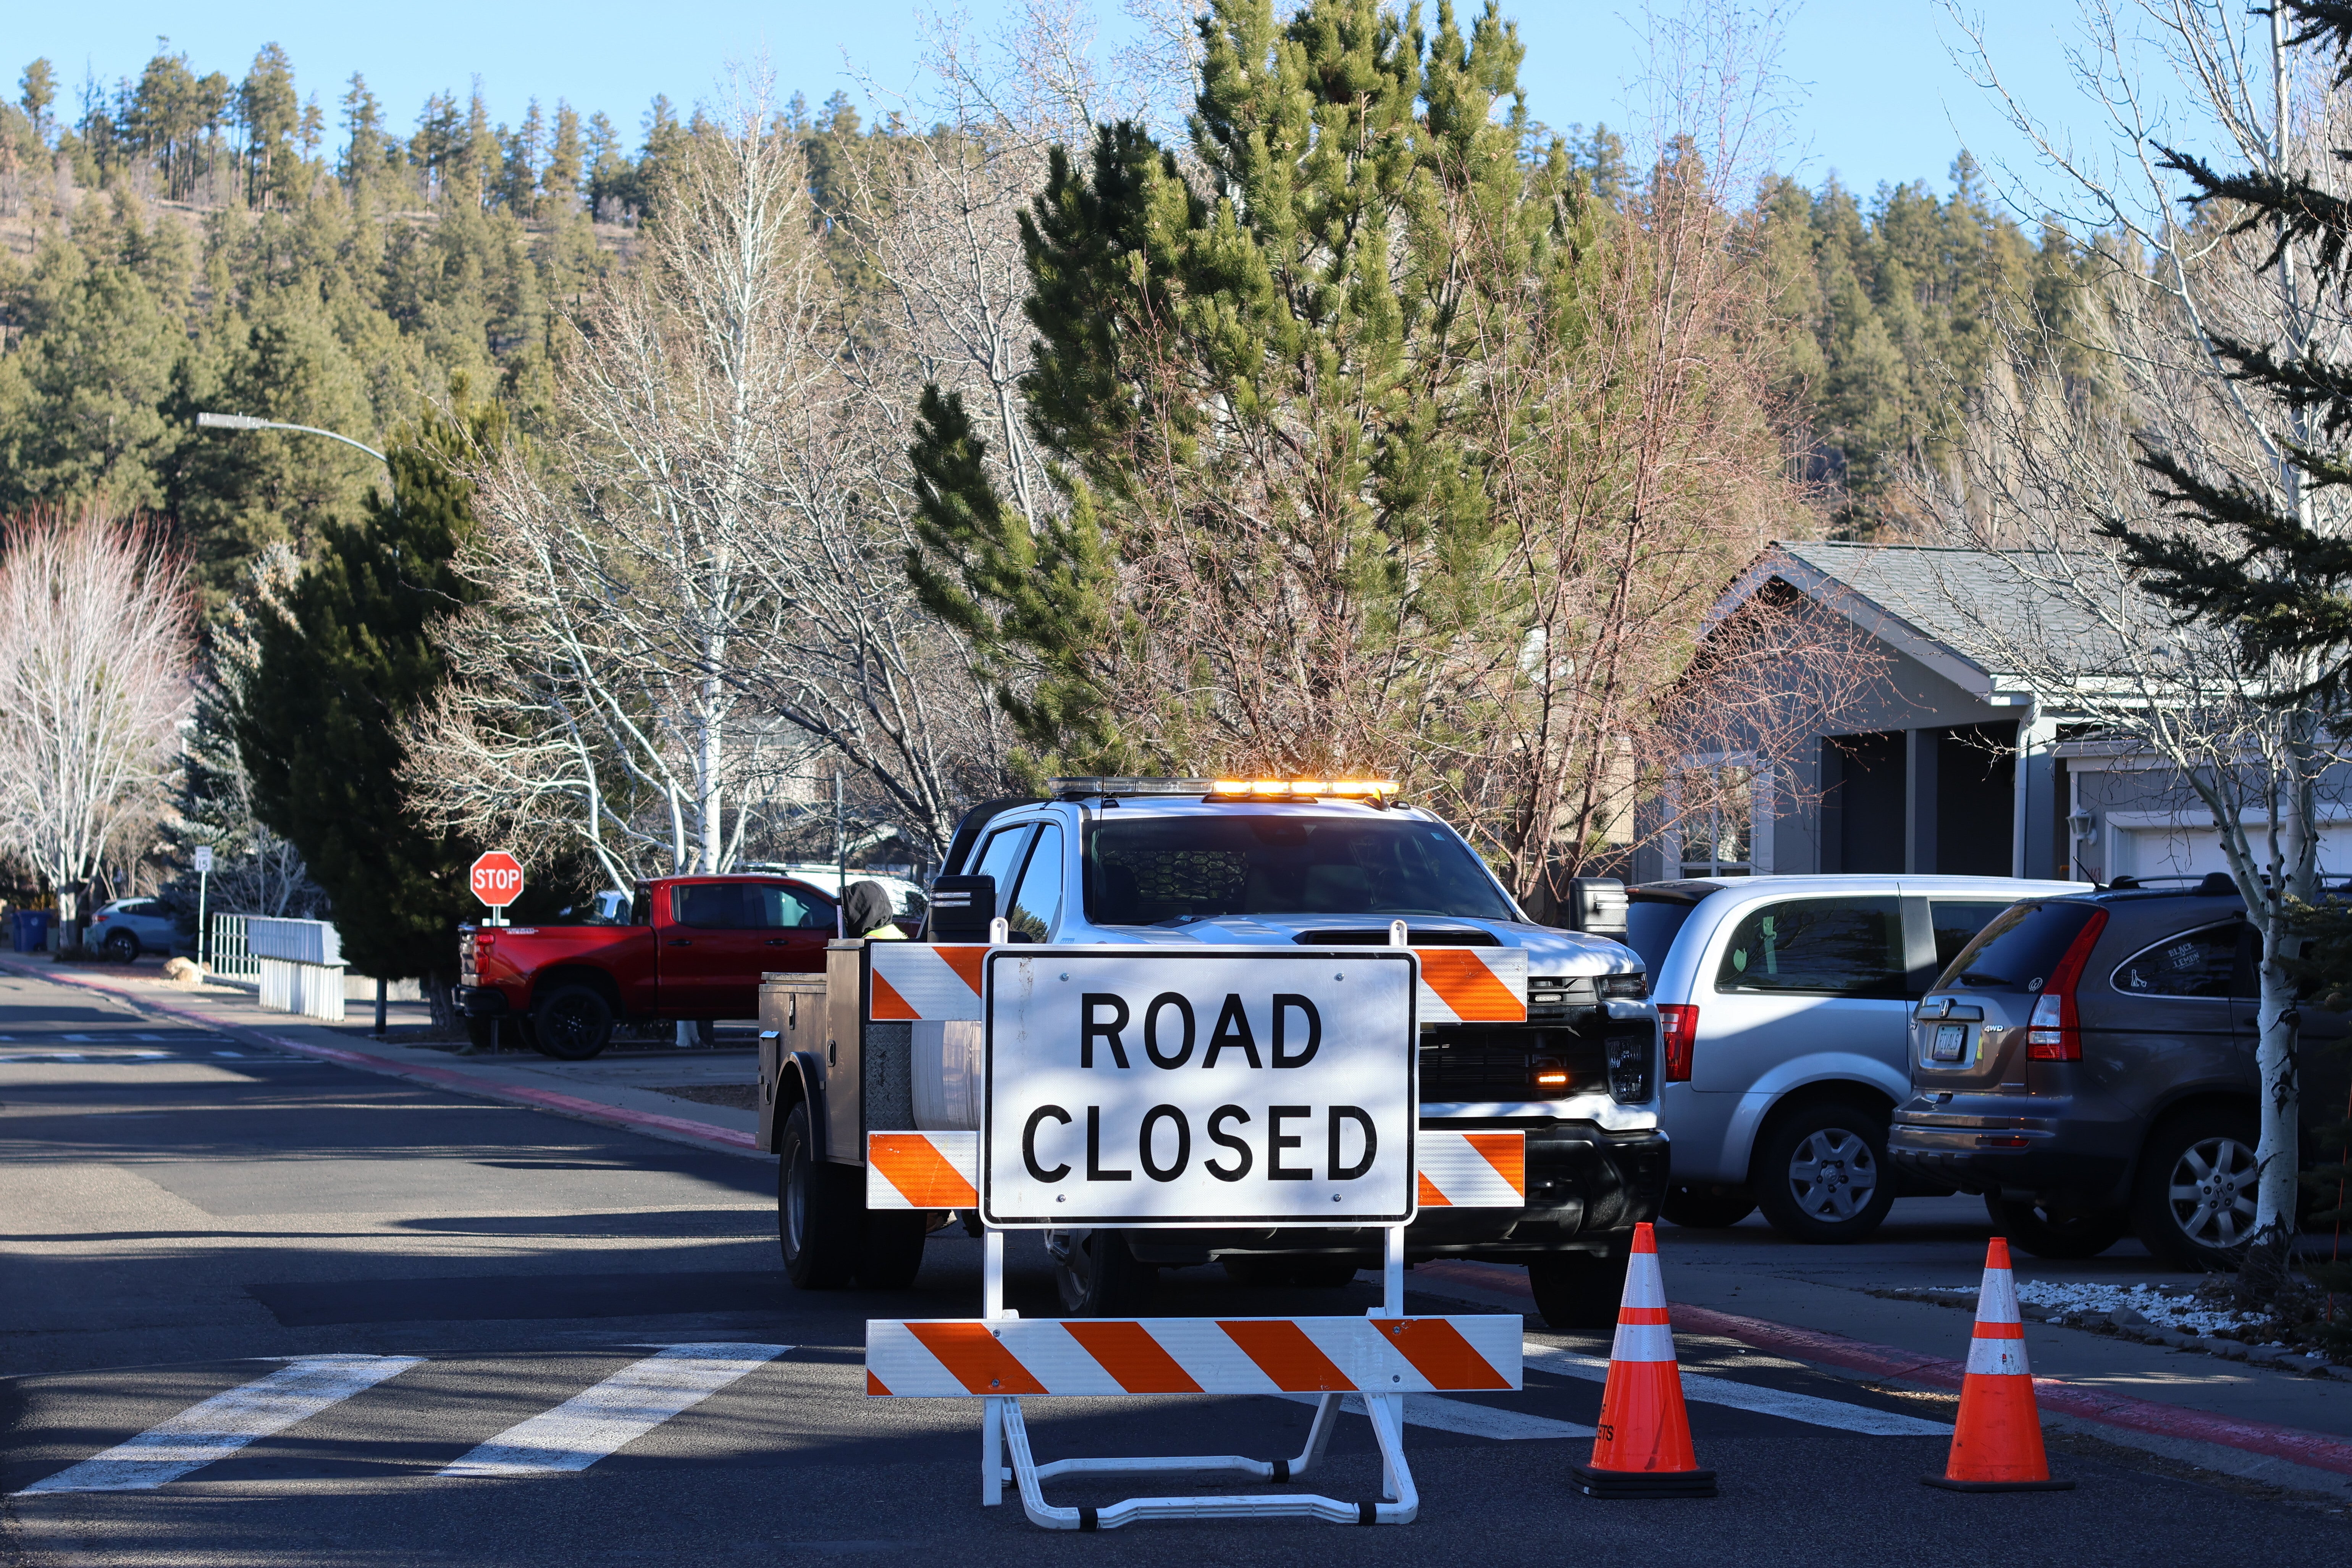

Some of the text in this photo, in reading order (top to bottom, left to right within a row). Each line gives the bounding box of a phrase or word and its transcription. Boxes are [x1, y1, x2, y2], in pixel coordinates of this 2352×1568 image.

[199, 859, 208, 869] 15
[474, 869, 520, 889] STOP
[2168, 942, 2194, 957] BLACK
[2173, 952, 2200, 967] LEMON
[1081, 992, 1321, 1070] ROAD
[1938, 1033, 1959, 1050] RIVALS
[1023, 1104, 1377, 1183] CLOSED
